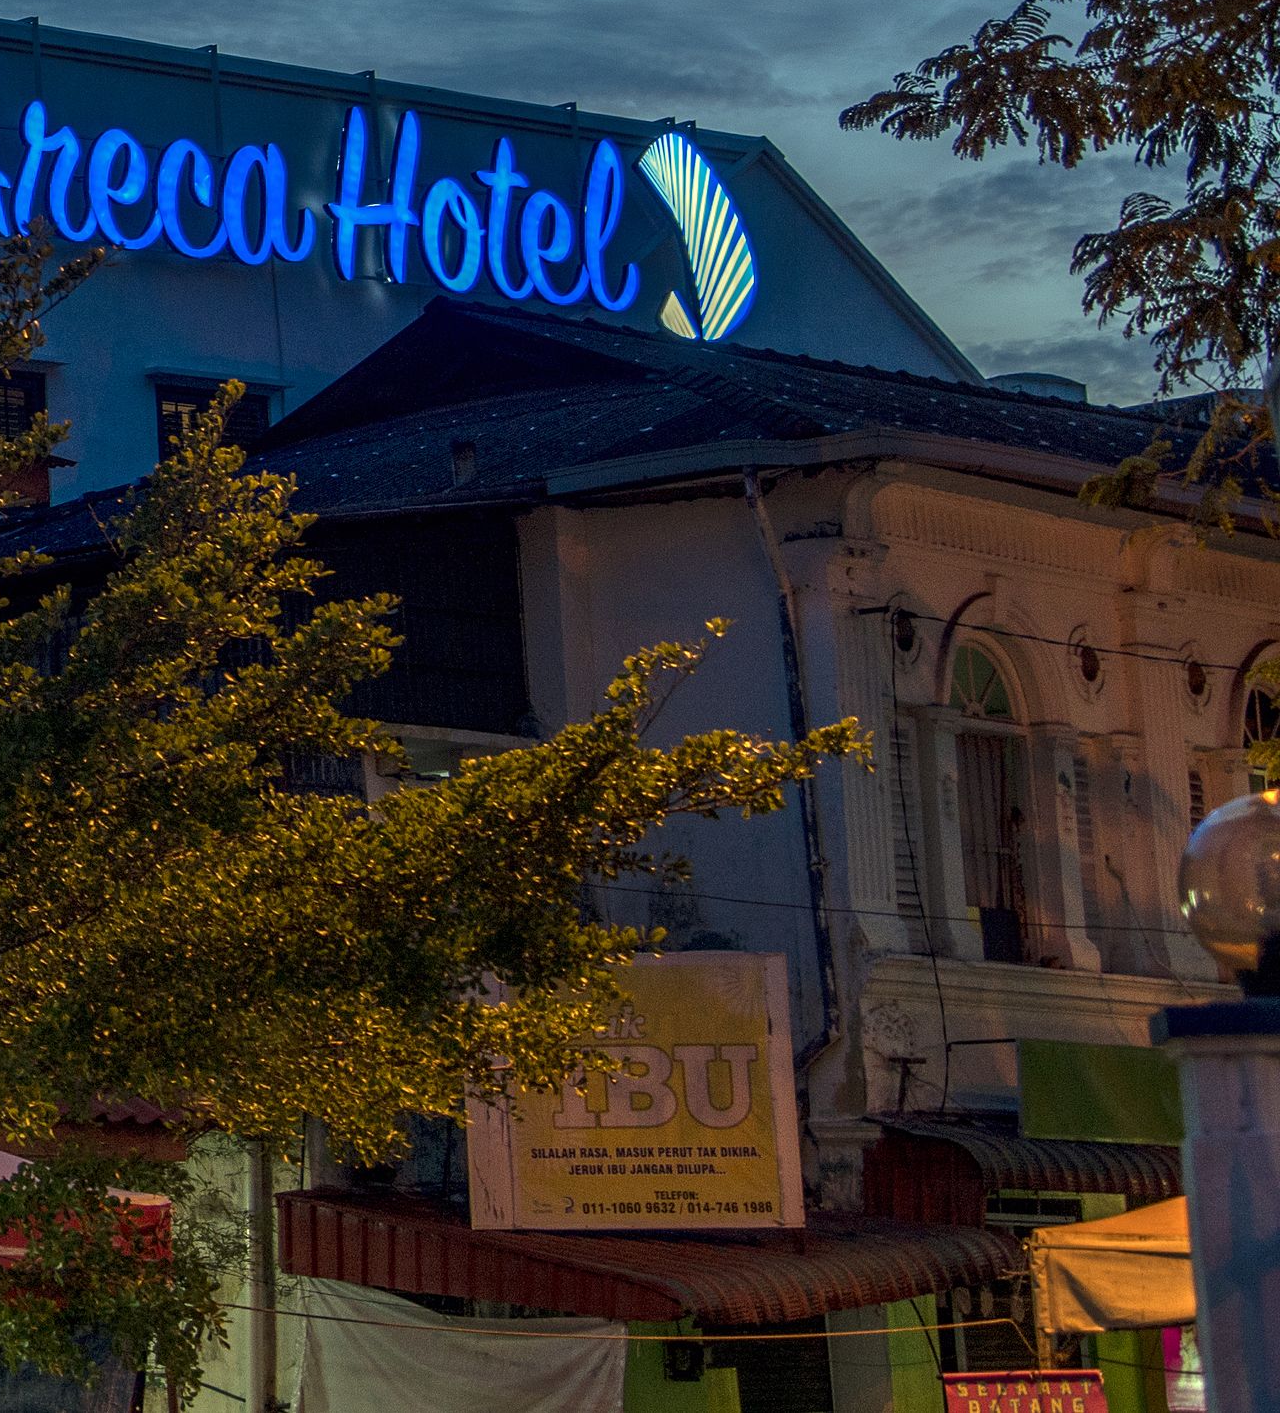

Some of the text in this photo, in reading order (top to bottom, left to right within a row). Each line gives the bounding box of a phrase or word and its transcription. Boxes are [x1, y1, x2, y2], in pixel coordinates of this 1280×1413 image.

[323, 105, 641, 312] Hotel
[552, 1042, 758, 1129] IBU
[531, 1146, 762, 1160] SILALAH RASA, MASUK PERUT TAK DIKIRA,
[568, 1164, 604, 1176] JERUK
[608, 1164, 627, 1175] IBU
[630, 1163, 673, 1175] JANGAN
[655, 1190, 699, 1201] TELEFON:
[582, 1202, 641, 1215] 011-1060
[645, 1202, 675, 1214] 9632
[687, 1202, 738, 1214] 014-746
[744, 1201, 773, 1213] 1986
